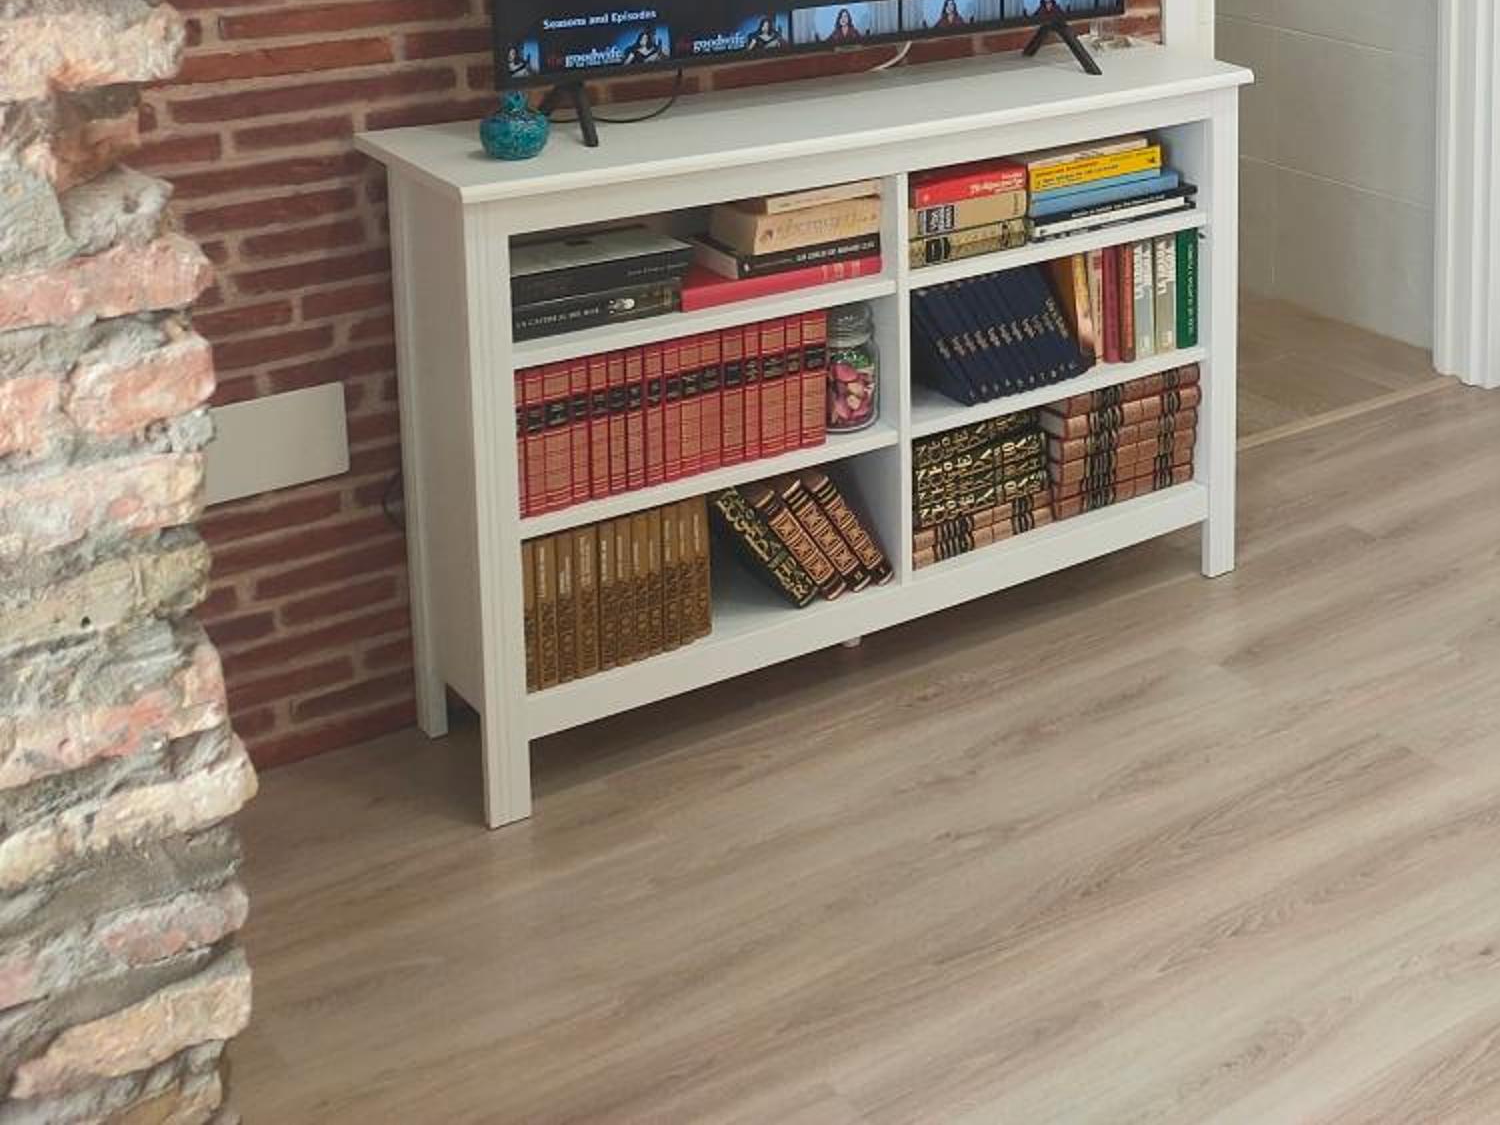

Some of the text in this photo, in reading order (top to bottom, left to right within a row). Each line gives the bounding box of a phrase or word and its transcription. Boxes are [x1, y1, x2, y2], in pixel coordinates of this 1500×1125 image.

[543, 8, 657, 30] Seasons and Episodes
